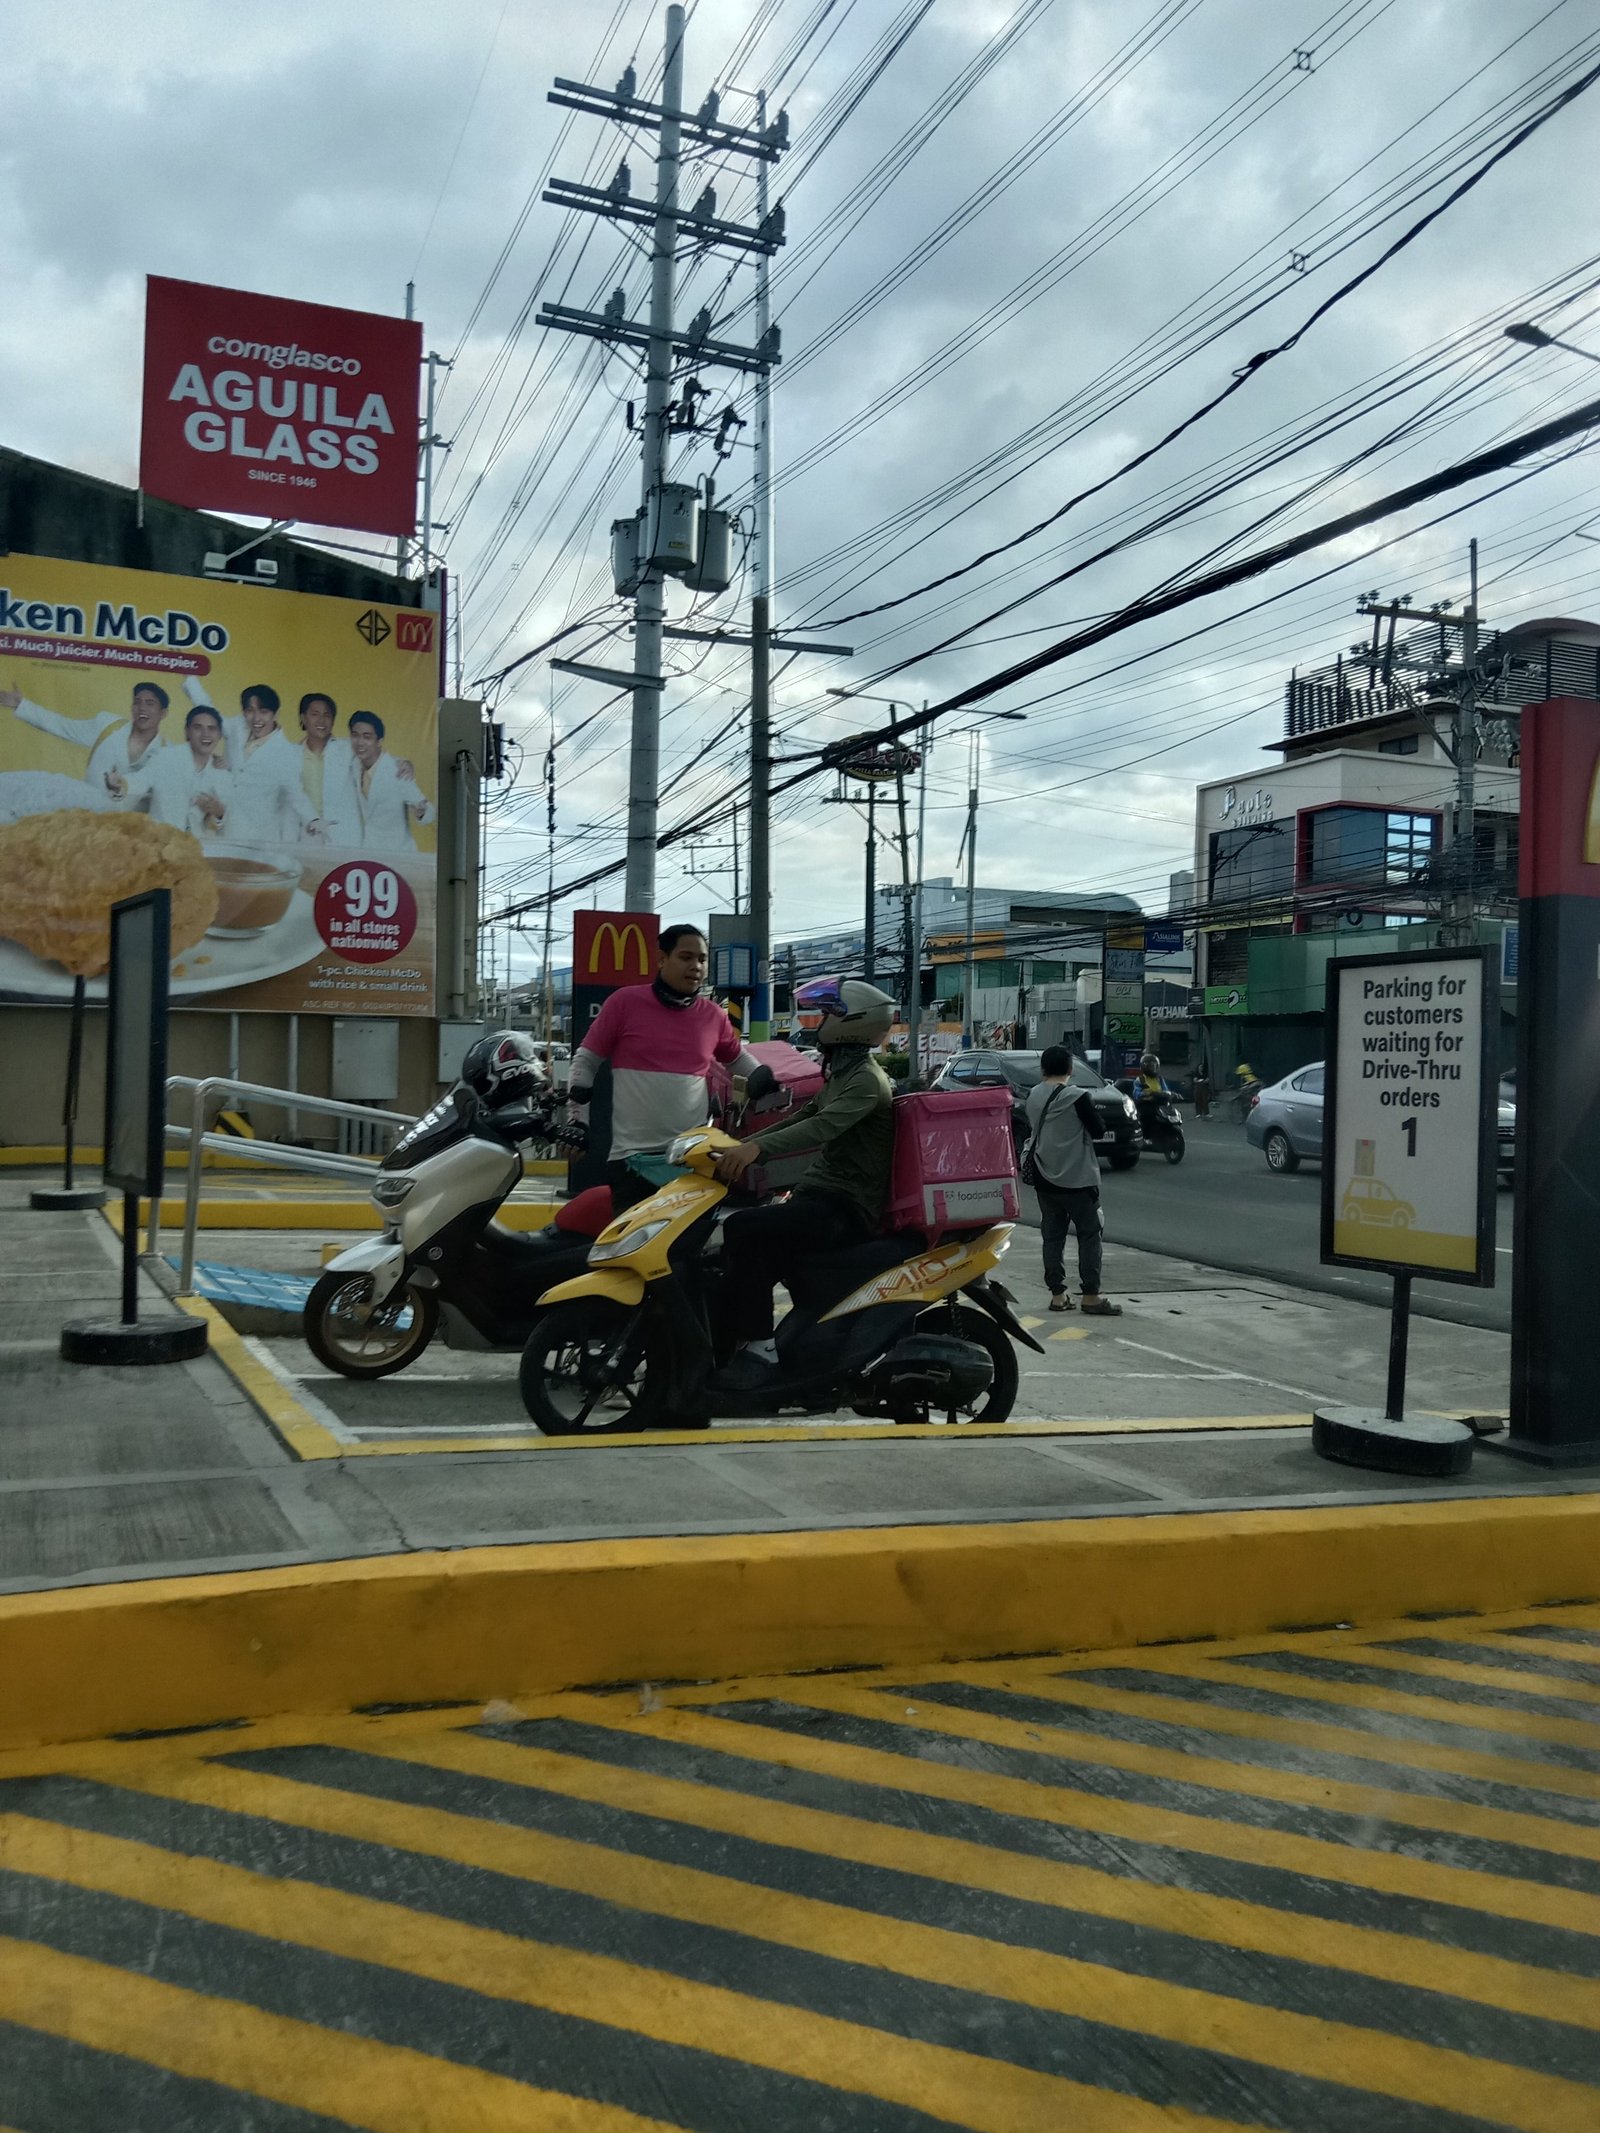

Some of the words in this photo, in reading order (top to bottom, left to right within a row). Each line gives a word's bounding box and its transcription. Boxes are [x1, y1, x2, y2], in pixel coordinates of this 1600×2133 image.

[208, 336, 361, 376] comglasco
[168, 363, 395, 434] AGUILA
[184, 411, 379, 475] GLASS
[248, 469, 287, 484] SINCE
[289, 475, 318, 488] 1946
[95, 602, 228, 652] McDo
[14, 639, 54, 653] Much
[55, 642, 103, 657] juicier.
[104, 648, 142, 663] Much
[144, 654, 199, 669] crispier.
[330, 919, 343, 932] in
[345, 919, 361, 933] all
[362, 921, 401, 936] stores
[331, 935, 400, 951] nationwide
[344, 966, 389, 977] Chicken
[391, 968, 422, 979] McDo
[309, 979, 335, 989] with
[336, 980, 357, 990] rice
[368, 981, 399, 992] small
[400, 982, 428, 993] drink
[1363, 977, 1432, 1001] Parking
[1438, 975, 1466, 997] for
[1364, 1006, 1463, 1026] customers
[1362, 1031, 1430, 1057] waiting
[1435, 1030, 1464, 1052] for
[1362, 1059, 1461, 1080] Drive-Thru
[1380, 1087, 1440, 1107] orders
[1401, 1117, 1417, 1157] 1
[957, 1188, 1003, 1201] foodpanda
